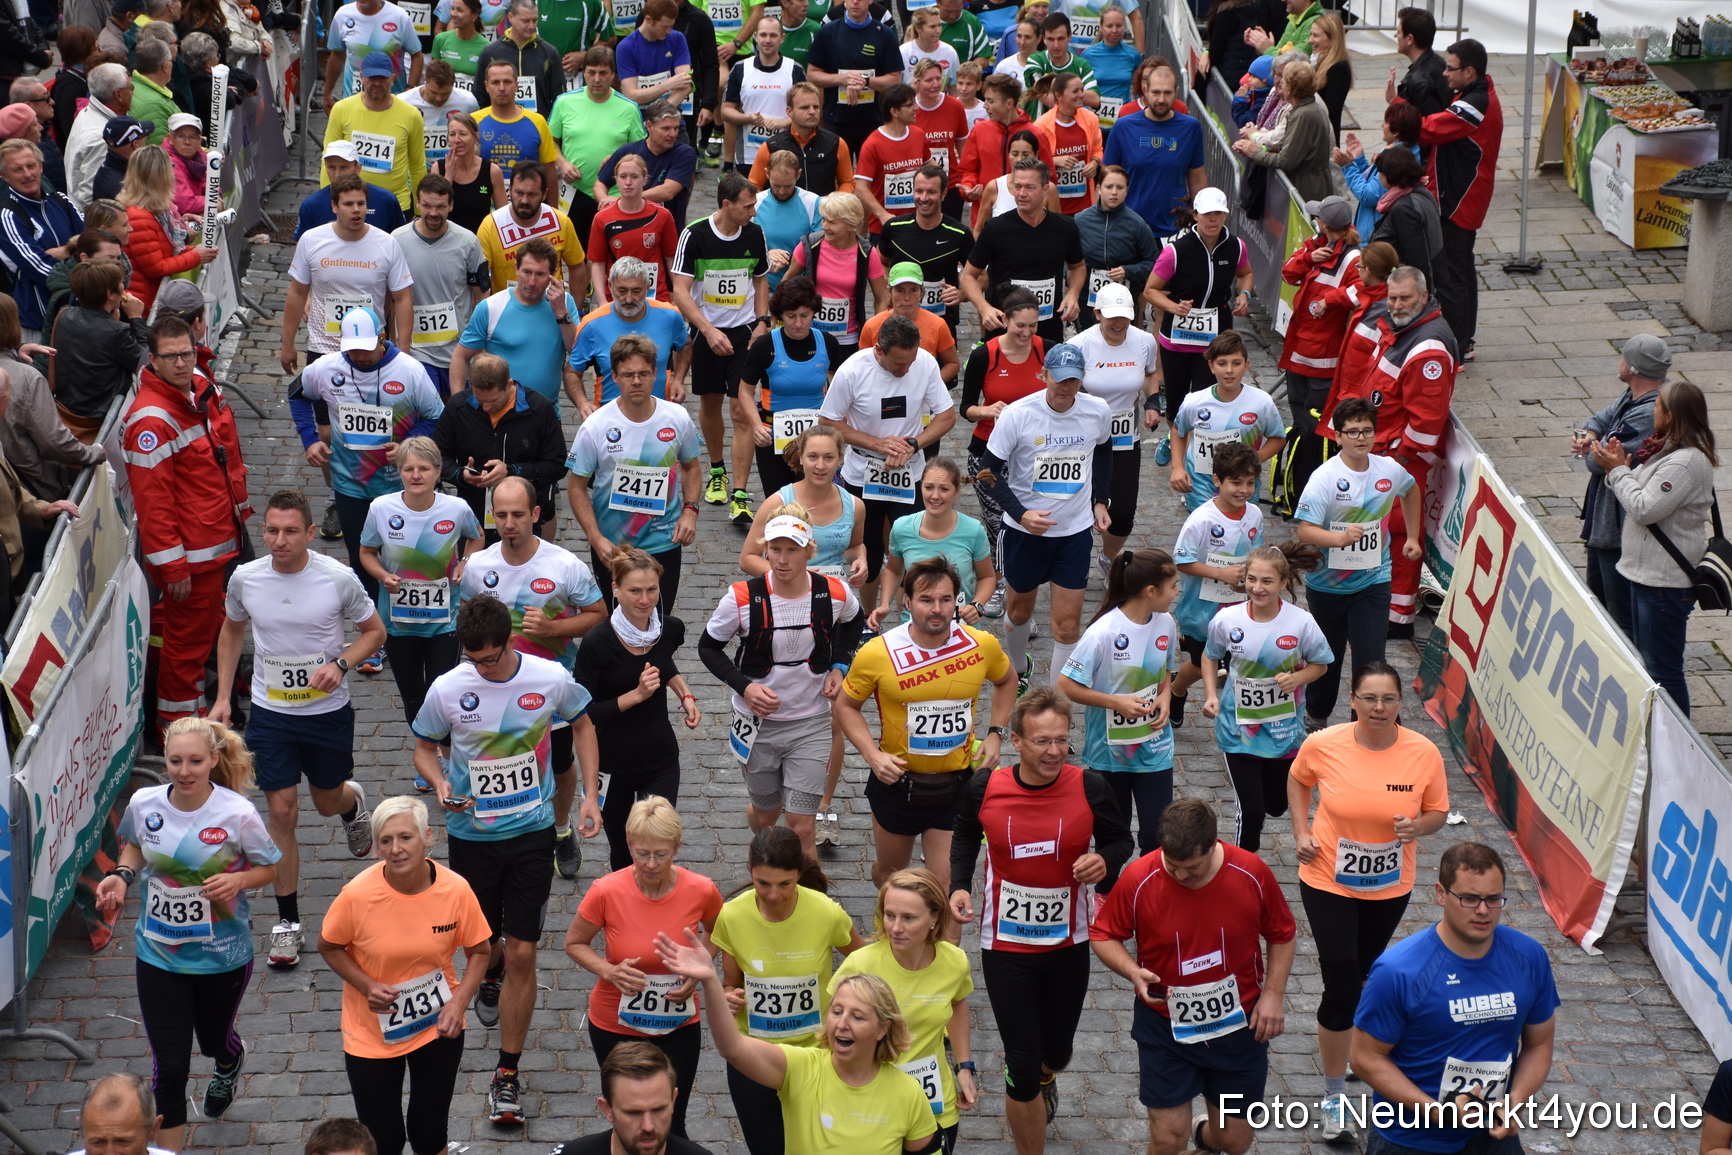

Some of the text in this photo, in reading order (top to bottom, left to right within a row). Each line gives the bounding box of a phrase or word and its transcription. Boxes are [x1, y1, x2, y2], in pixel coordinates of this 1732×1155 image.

[616, 4, 643, 16] 2734
[711, 6, 740, 19] 2153
[1072, 23, 1100, 37] 2708
[208, 75, 222, 148] BMW Laufsport
[424, 135, 449, 150] 276
[355, 141, 390, 160] 2214
[363, 158, 378, 168] Hans
[883, 157, 920, 171] NEUMARKT
[1055, 170, 1085, 186] 2360
[208, 175, 220, 204] BMW
[1059, 186, 1078, 194] Sandra
[319, 256, 371, 269] Continental
[717, 279, 737, 295] 65
[715, 296, 737, 304] Markus
[816, 307, 846, 322] 669
[419, 313, 449, 332] 512
[1176, 316, 1214, 332] 2751
[344, 413, 389, 434] 3064
[616, 466, 635, 475] PARTL
[1038, 462, 1081, 481] 2008
[868, 468, 911, 489] 2806
[617, 475, 664, 498] 2417
[878, 486, 900, 496] Martin
[622, 496, 653, 508] Andreas
[396, 588, 445, 606] 2614
[409, 609, 432, 618] Ulrike
[264, 658, 315, 668] PARTL Neumarkt
[281, 669, 309, 688] 38
[898, 652, 985, 691] MAX BÖGL
[1236, 678, 1255, 688] PARTL
[282, 691, 311, 702] Tobias
[521, 696, 544, 707] Hervis
[1241, 688, 1290, 707] 5314
[909, 704, 962, 713] PARTL Neumarkt
[914, 711, 968, 735] 2755
[927, 739, 954, 749] Marco
[1477, 646, 1606, 851] PFLASTERSTEINE
[470, 759, 527, 773] PARTL Neumarkt
[477, 766, 534, 795] 2319
[1386, 784, 1414, 793] THULE
[486, 793, 531, 809] Sebastian
[1025, 845, 1044, 855] DEHN
[1338, 842, 1395, 854] PARTL Neumarkt
[1342, 851, 1398, 875] 2083
[1359, 878, 1379, 886] Elke
[163, 891, 197, 901] Neumarkt
[1002, 885, 1059, 900] PARTL Neumarkt
[151, 894, 205, 924] 2433
[1005, 897, 1064, 923] 2132
[157, 923, 194, 938] Ramona
[1015, 925, 1051, 937] Markus
[1193, 957, 1212, 970] DEHN
[401, 978, 435, 997] Neumarkt
[649, 980, 682, 988] Neumarkt
[746, 979, 807, 991] PARTL Neumarkt
[1171, 984, 1227, 999] ARTL Neumarkt
[387, 985, 445, 1028] 2431
[752, 989, 815, 1015] 2378
[1175, 991, 1236, 1024] 2399
[1448, 991, 1517, 1015] HUBER
[1463, 1007, 1515, 1020] TECHNOLOGY
[407, 1017, 434, 1035] Anita
[632, 1016, 679, 1029] Marianne
[766, 1017, 803, 1032] Brigitte
[1447, 1063, 1474, 1075] PARTL
